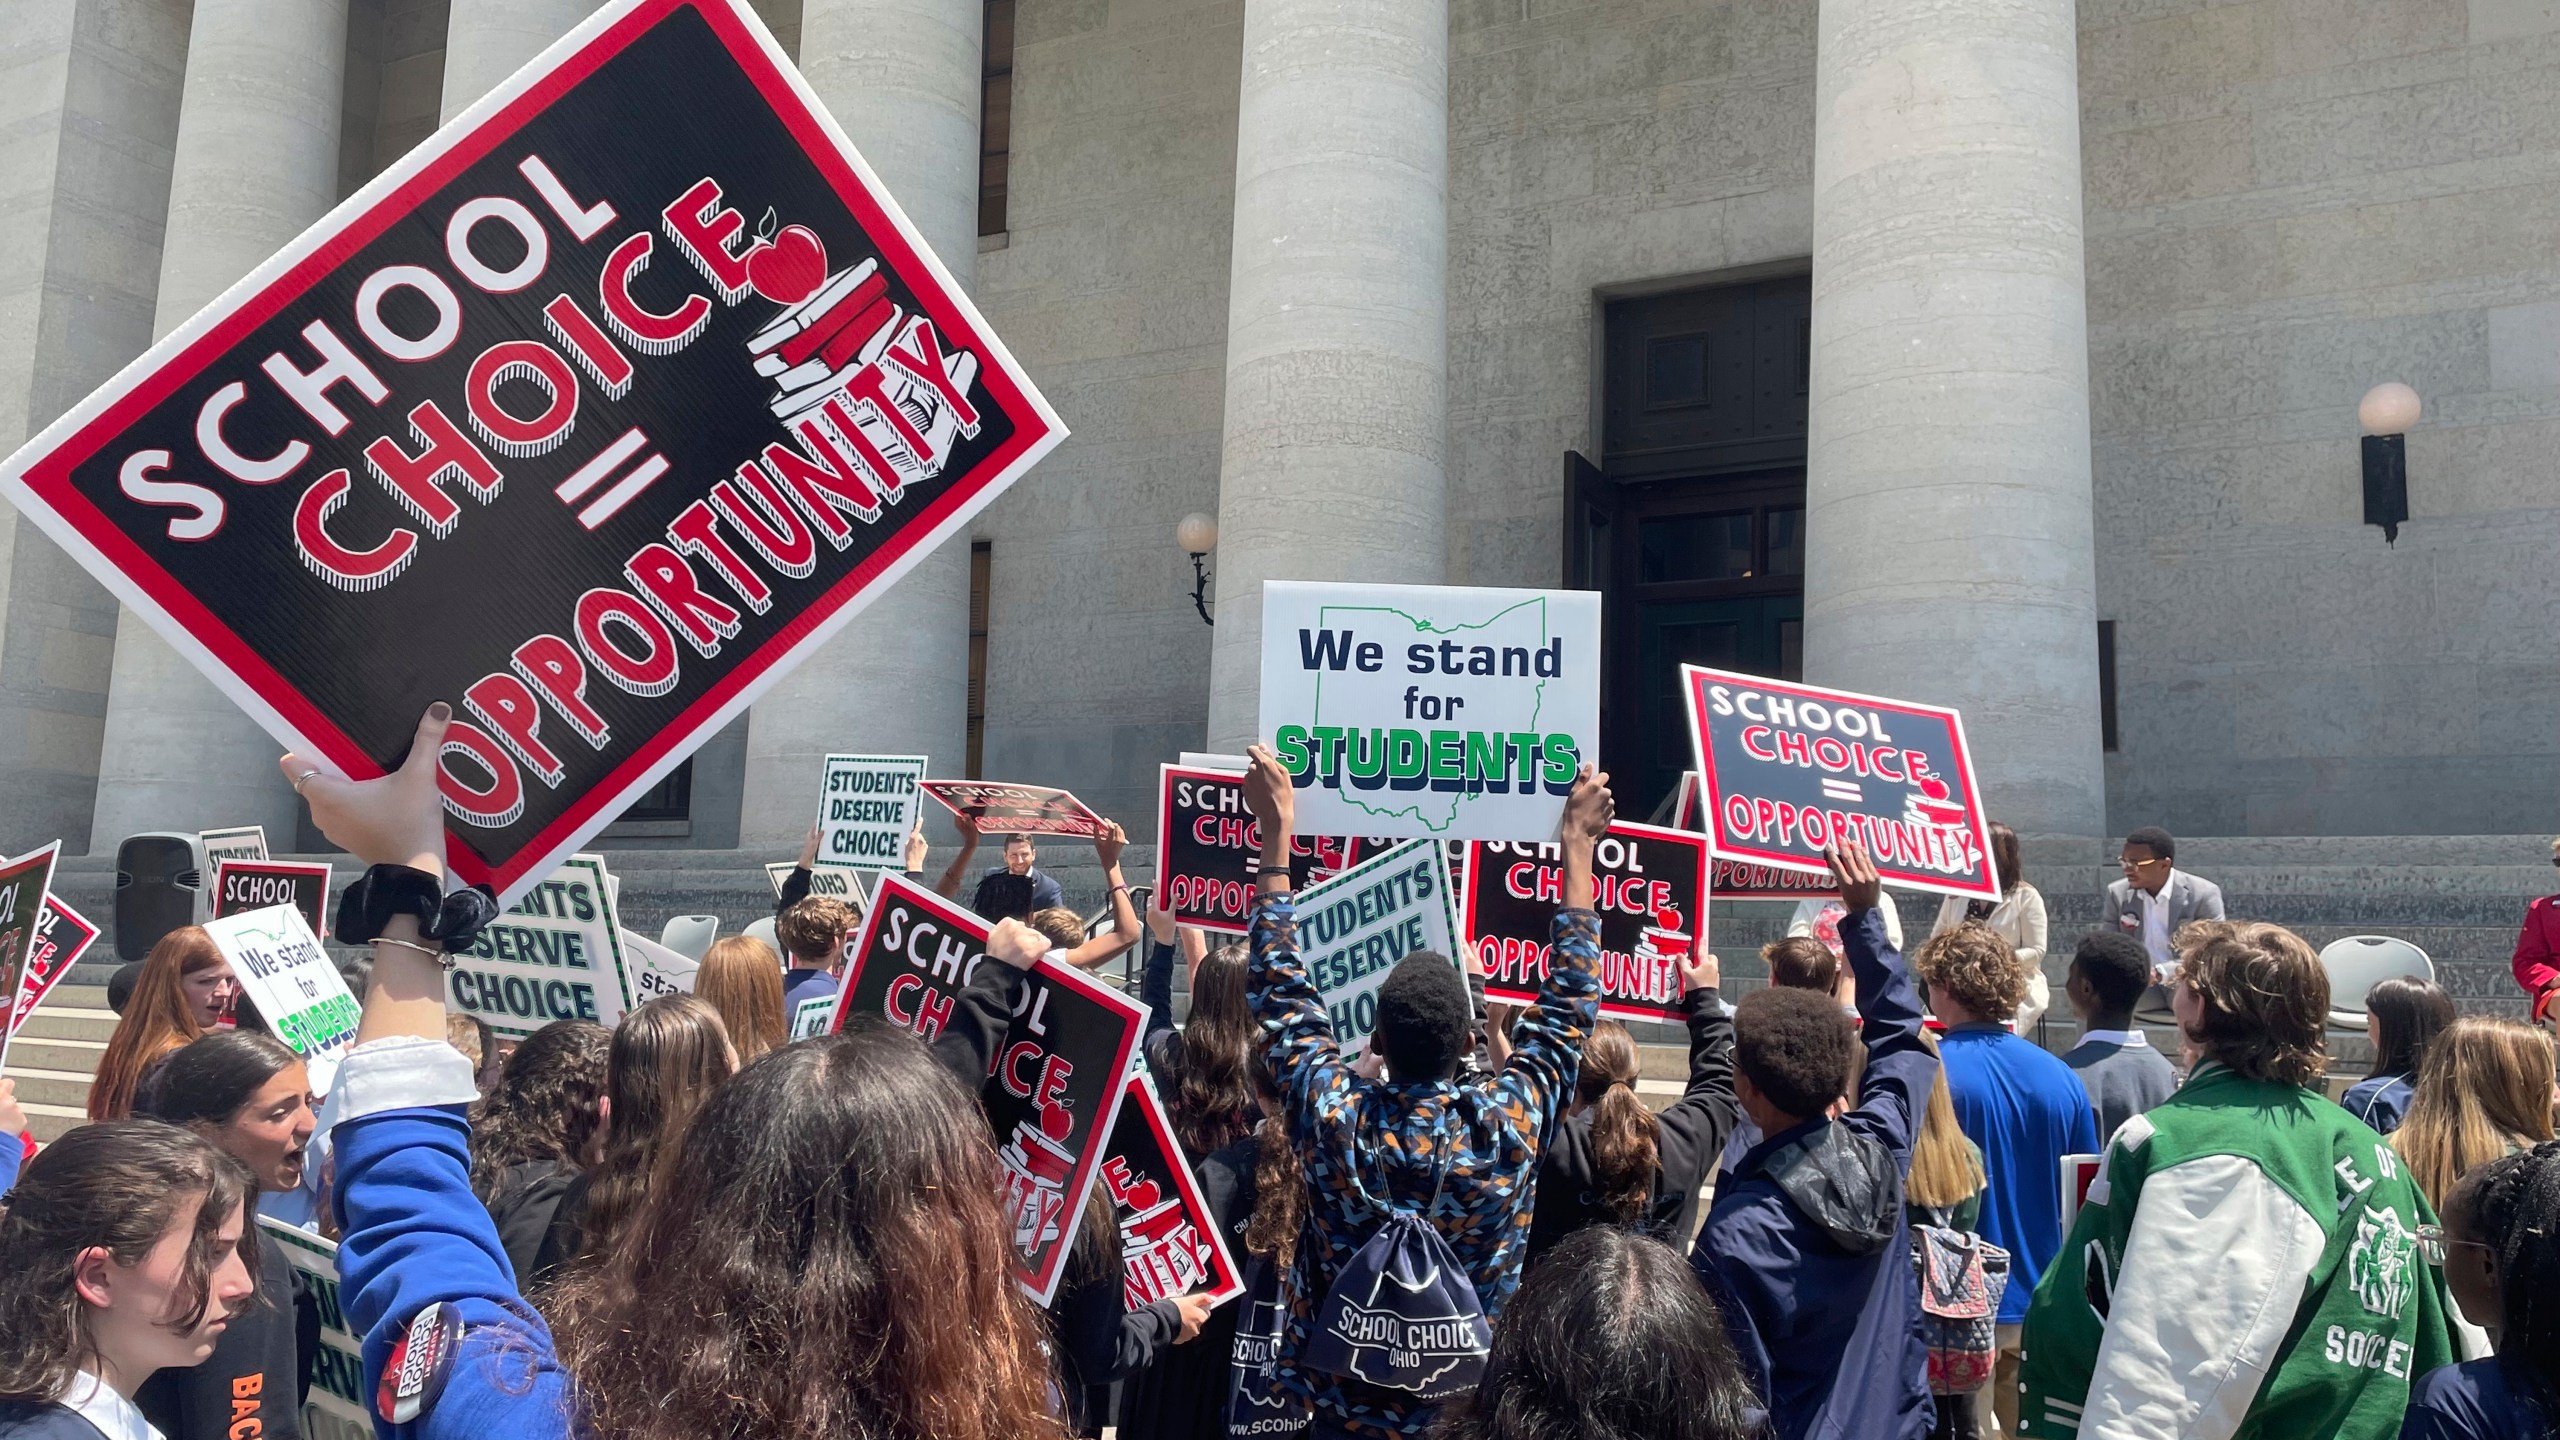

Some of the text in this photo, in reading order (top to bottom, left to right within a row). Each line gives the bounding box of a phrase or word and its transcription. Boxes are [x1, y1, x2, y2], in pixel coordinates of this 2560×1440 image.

[117, 154, 618, 542] SCHOOL
[293, 176, 753, 593] CHOICE
[436, 319, 981, 829] OPPORTUNITY
[1298, 628, 1563, 678] We stand
[1403, 685, 1465, 721] for
[1709, 684, 1892, 743] SCHOOL
[1274, 724, 1581, 797] STUDENTS
[1740, 724, 1929, 786] CHOICE
[829, 770, 916, 794] STUDENTS
[935, 785, 1039, 800] SCHOOL
[1177, 781, 1254, 815] SCH
[830, 799, 904, 824] DESERVE
[1725, 793, 1974, 875] OPPORTUNITY
[832, 829, 900, 857] CHOICE
[225, 874, 297, 904] SCHOOL
[1297, 858, 1435, 954] TUDENTS
[238, 933, 321, 980] We stand
[456, 923, 590, 970] SERVE
[294, 976, 320, 999] for
[450, 968, 601, 1022] CHOICE
[883, 973, 1074, 1112] CHCE
[2374, 1142, 2398, 1182] OF
[1338, 1304, 1480, 1351] SCHOOL CHOICE
[400, 1323, 423, 1394] CHOICE
[410, 1317, 434, 1393] SCHOOL
[1389, 1350, 1421, 1369] OHIO
[229, 1372, 264, 1440] BAC
